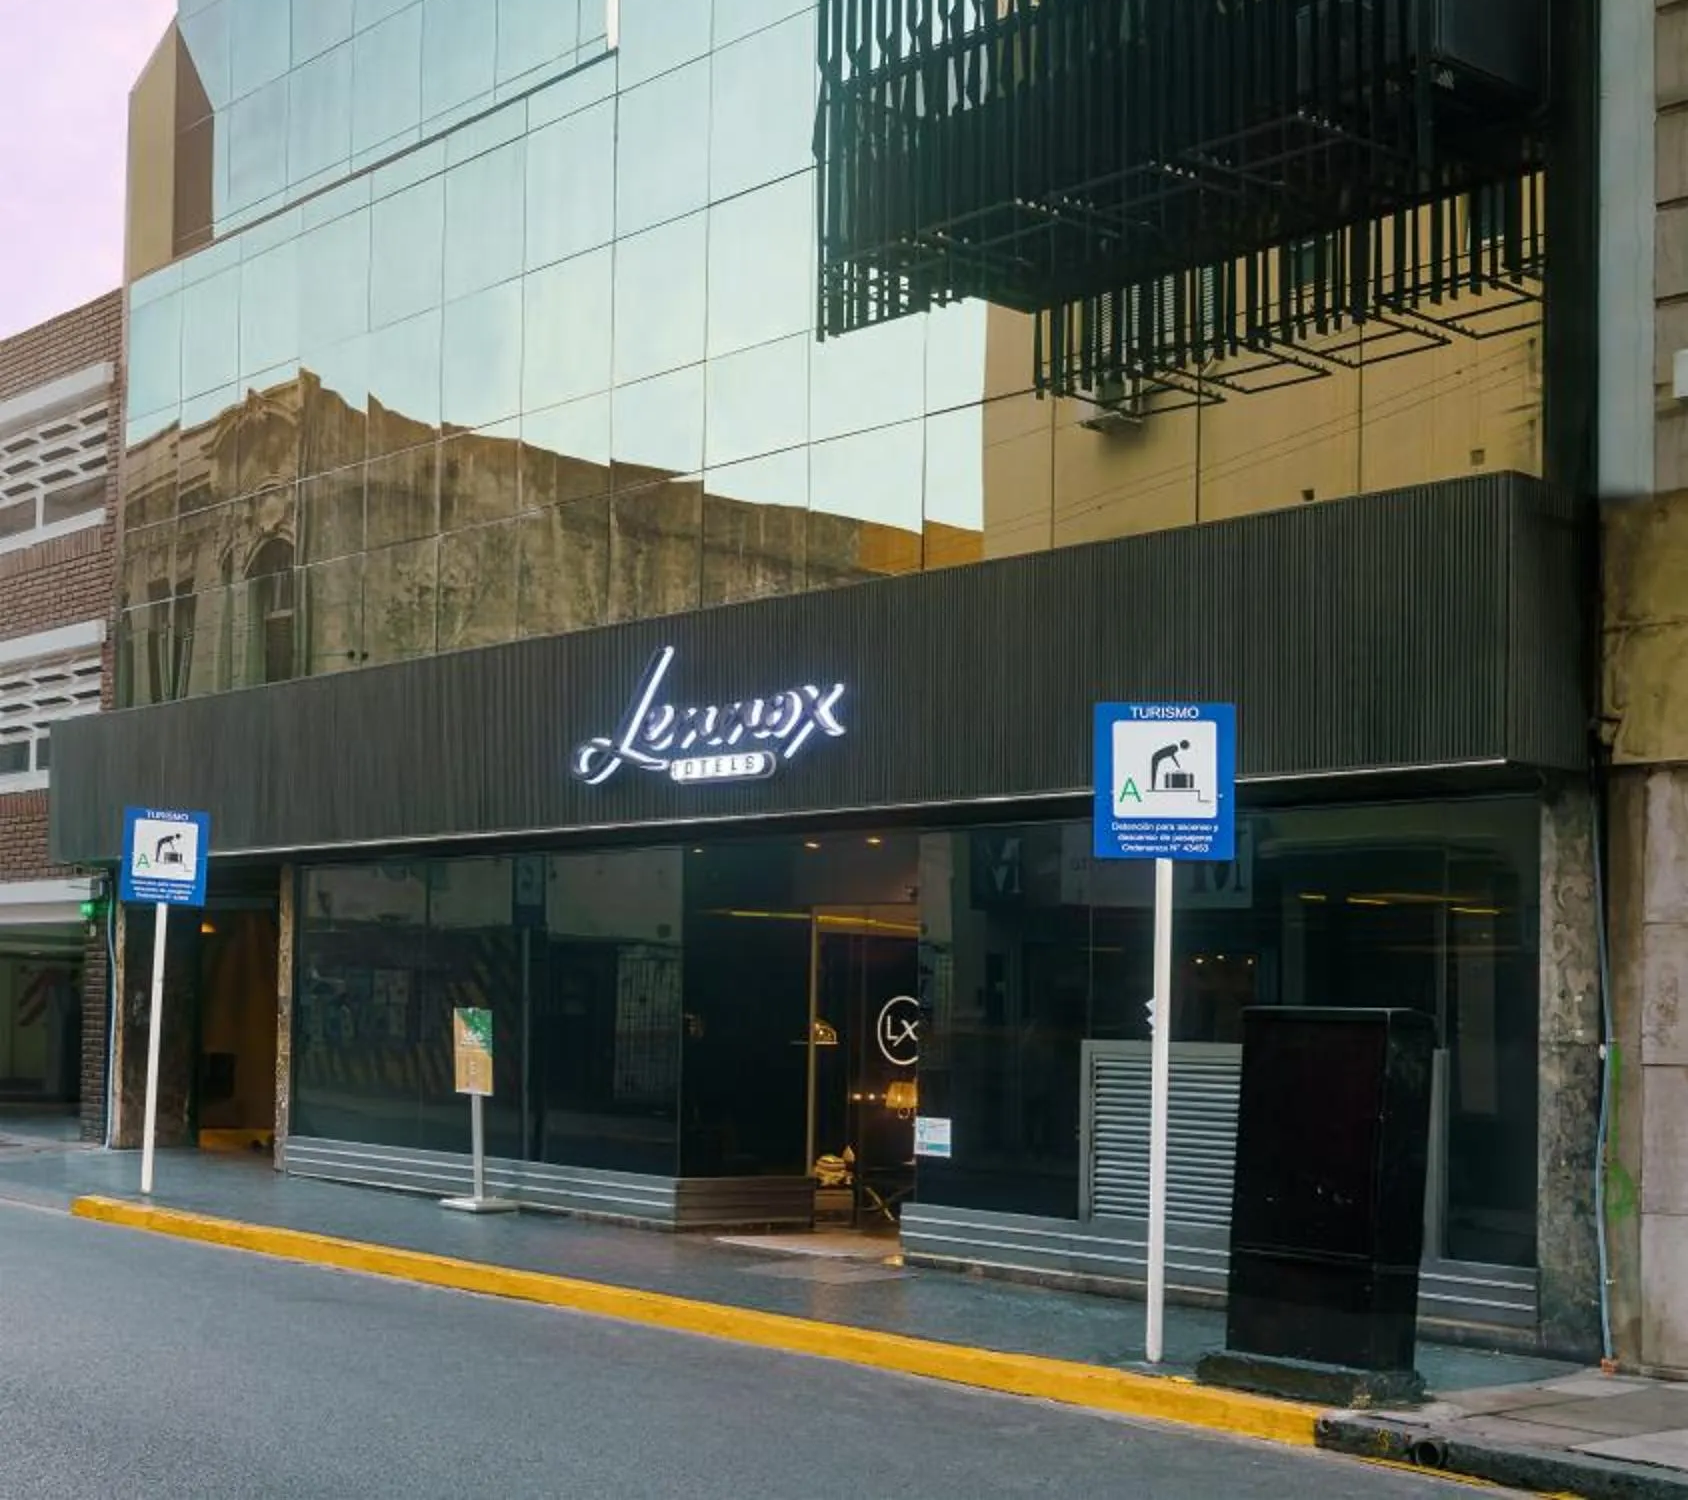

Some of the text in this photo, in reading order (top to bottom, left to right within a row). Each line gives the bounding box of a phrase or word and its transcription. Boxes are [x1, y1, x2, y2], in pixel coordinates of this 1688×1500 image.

[571, 645, 847, 785] Lennox
[1130, 706, 1200, 719] TURISMO
[1119, 777, 1142, 803] A
[146, 811, 189, 820] TURISMO
[1111, 821, 1154, 831] Detención
[1155, 823, 1175, 832] para
[1213, 824, 1219, 833] y
[886, 1015, 920, 1047] LX
